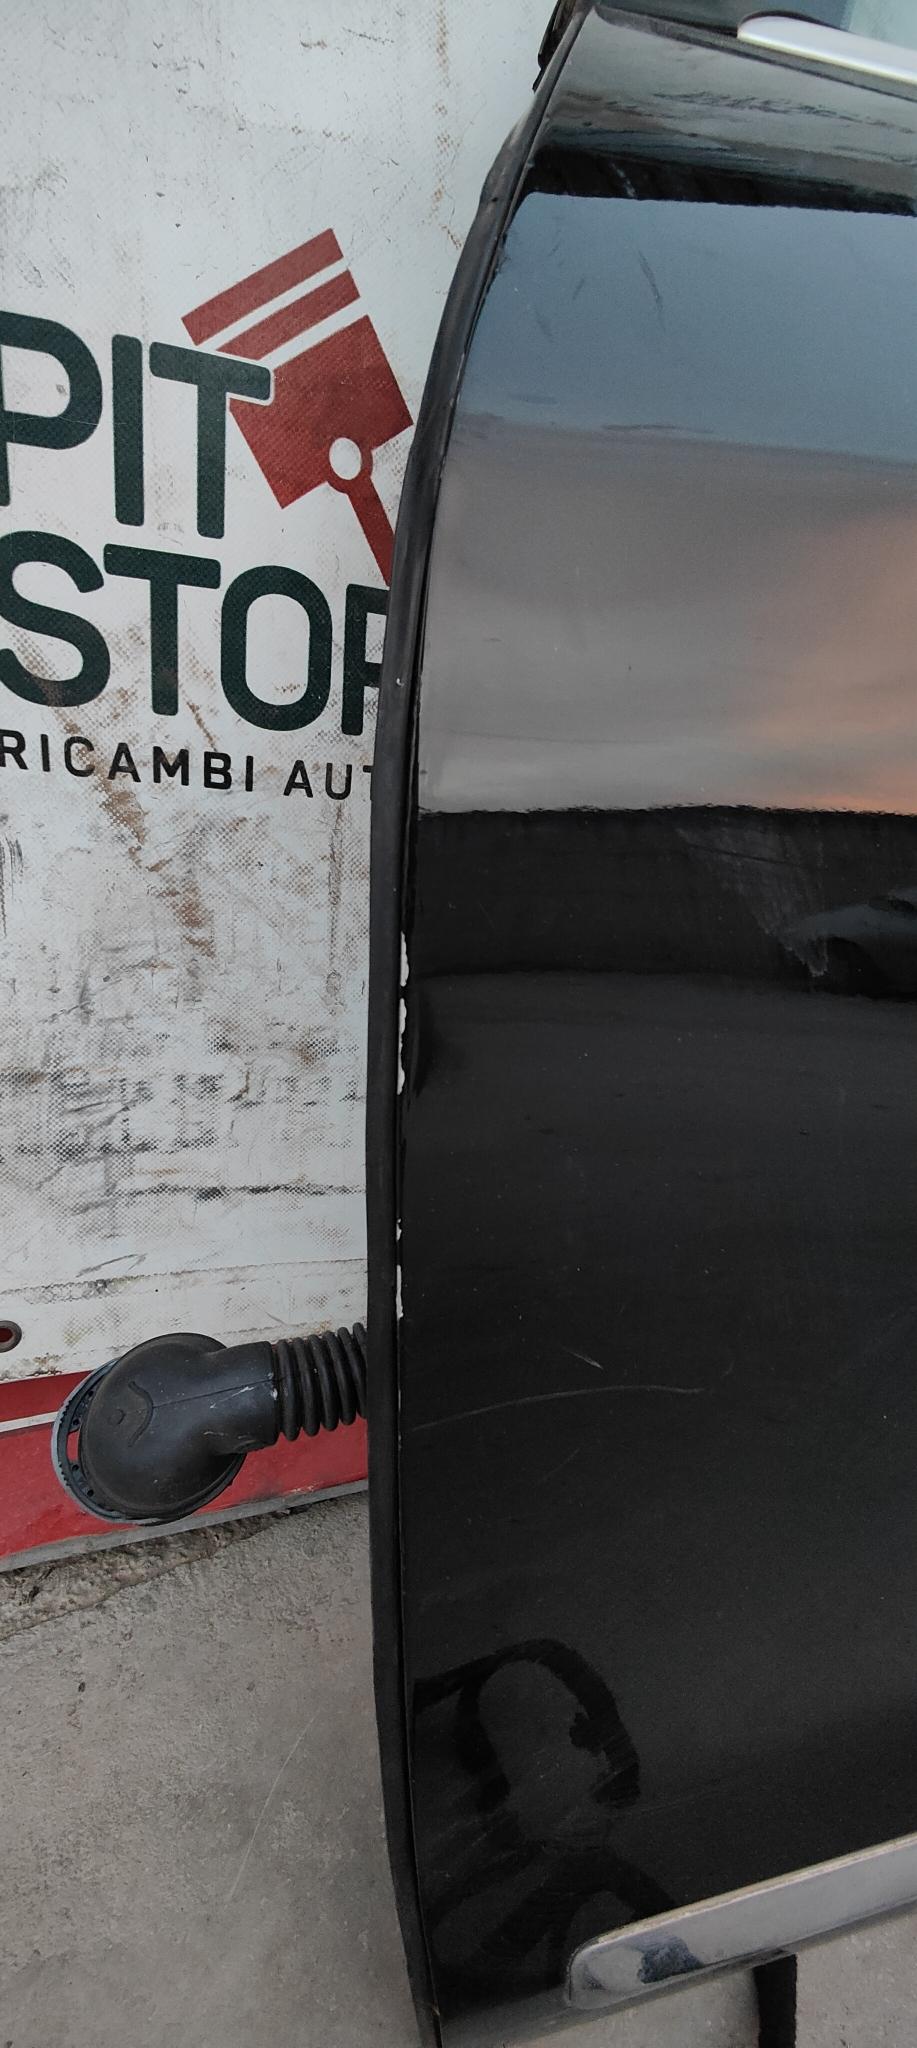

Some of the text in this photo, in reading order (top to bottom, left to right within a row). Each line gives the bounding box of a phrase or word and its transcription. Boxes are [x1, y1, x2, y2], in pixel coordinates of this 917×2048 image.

[0, 310, 271, 539] PIT
[0, 728, 374, 800] RICAMBI AU
